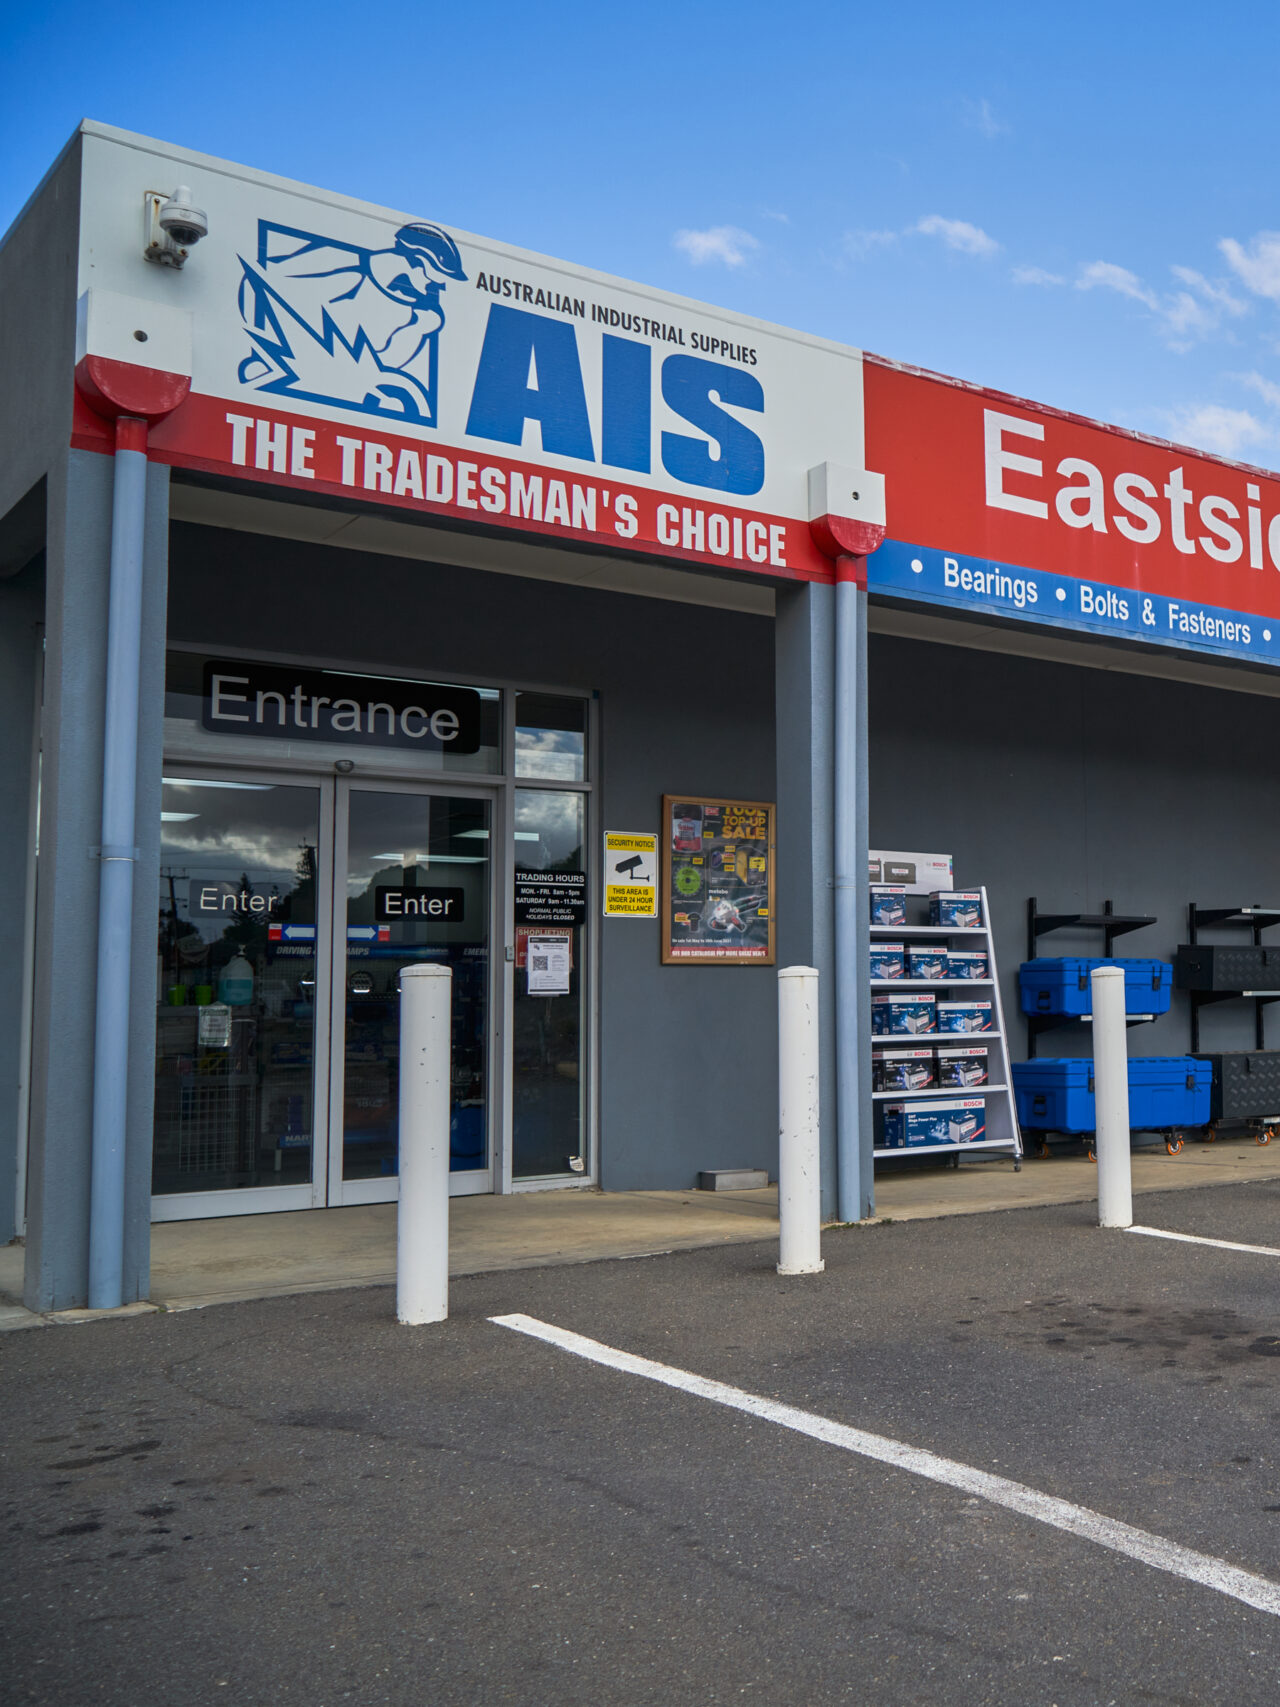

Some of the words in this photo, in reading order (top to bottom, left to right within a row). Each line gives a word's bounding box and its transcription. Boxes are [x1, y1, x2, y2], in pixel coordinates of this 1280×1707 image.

[476, 272, 586, 318] AUSTRALIAN
[591, 303, 686, 347] INDUSTRIAL
[690, 331, 758, 366] SUPPLIES
[465, 303, 765, 496] AIS
[226, 412, 316, 479] THE
[336, 435, 639, 539] TRADESMAN'S
[656, 503, 787, 567] CHOICE
[943, 556, 1038, 609] Bearings
[1080, 585, 1130, 622] Bolts
[1142, 599, 1156, 627] &
[1168, 604, 1252, 645] Fasteners
[211, 673, 460, 741] Entrance
[722, 816, 766, 828] TOP-UP
[721, 825, 766, 840] SALE
[607, 838, 634, 847] SECURITY
[634, 840, 655, 849] NOTICE
[516, 873, 554, 882] TRADING
[555, 874, 585, 883] HOURS
[626, 888, 641, 896] AREA
[200, 887, 279, 912] Enter
[384, 892, 454, 915] Enter
[608, 896, 628, 904] UNDER
[629, 896, 636, 904] 24
[609, 904, 652, 912] SURVEILLANCE
[518, 928, 571, 936] SHOPLIFTING
[276, 946, 312, 955] DRIVING
